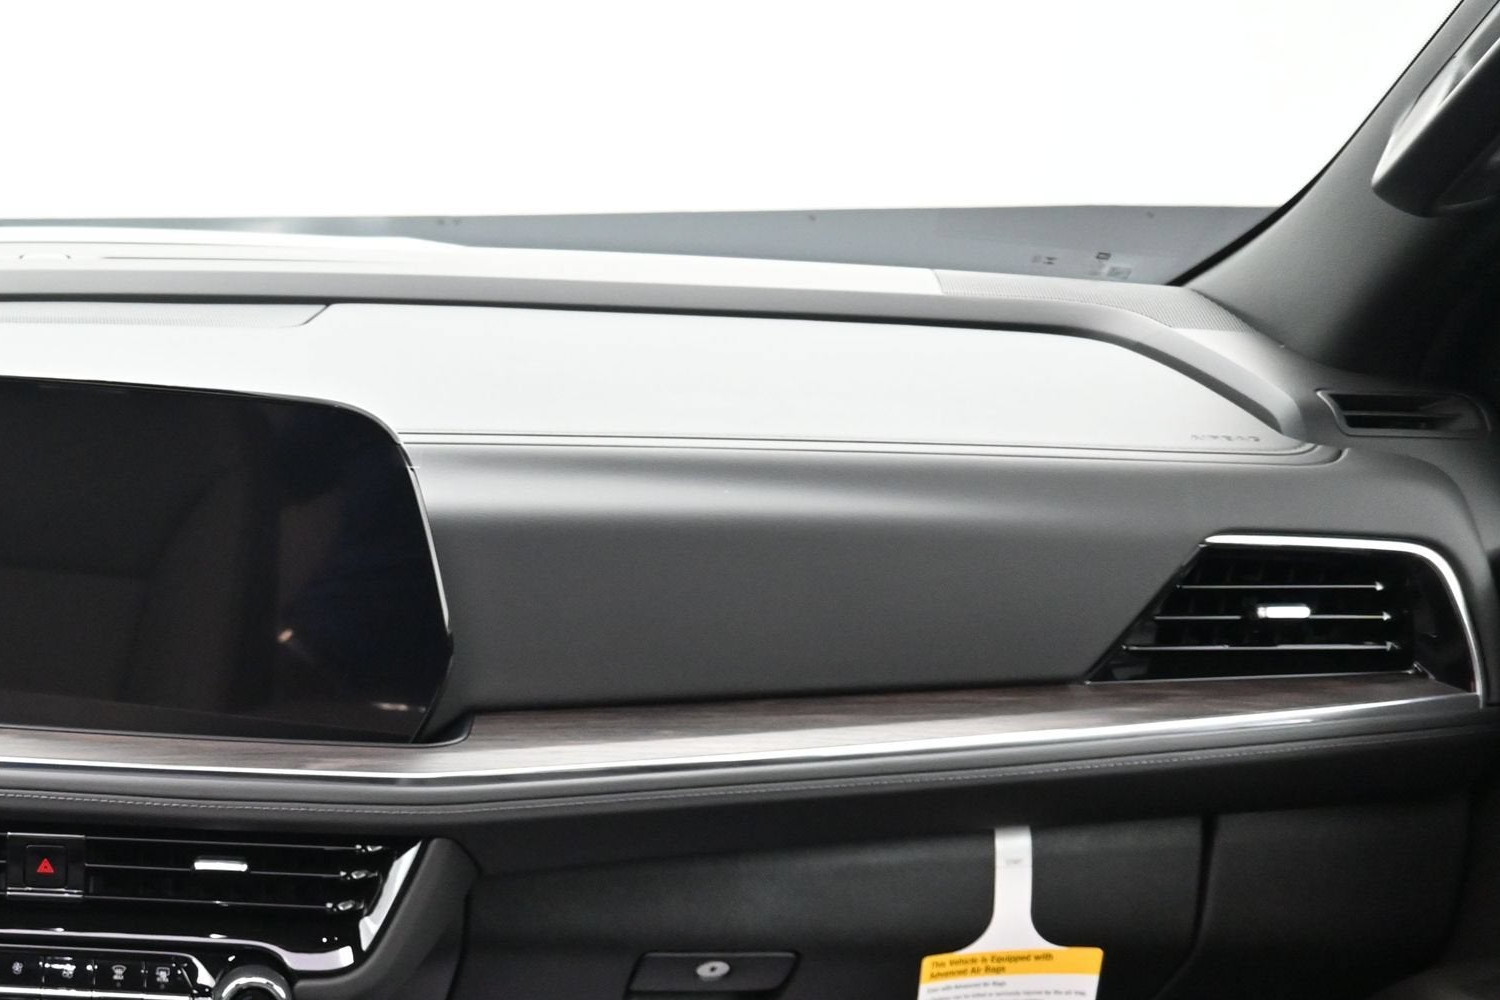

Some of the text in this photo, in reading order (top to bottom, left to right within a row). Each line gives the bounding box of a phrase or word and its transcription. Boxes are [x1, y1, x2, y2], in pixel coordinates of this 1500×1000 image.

[931, 960, 946, 969] This
[949, 956, 978, 966] Vehicle
[990, 953, 1032, 964] Equipped
[1034, 952, 1054, 961] with
[930, 964, 1006, 979] Advanced Air Bags
